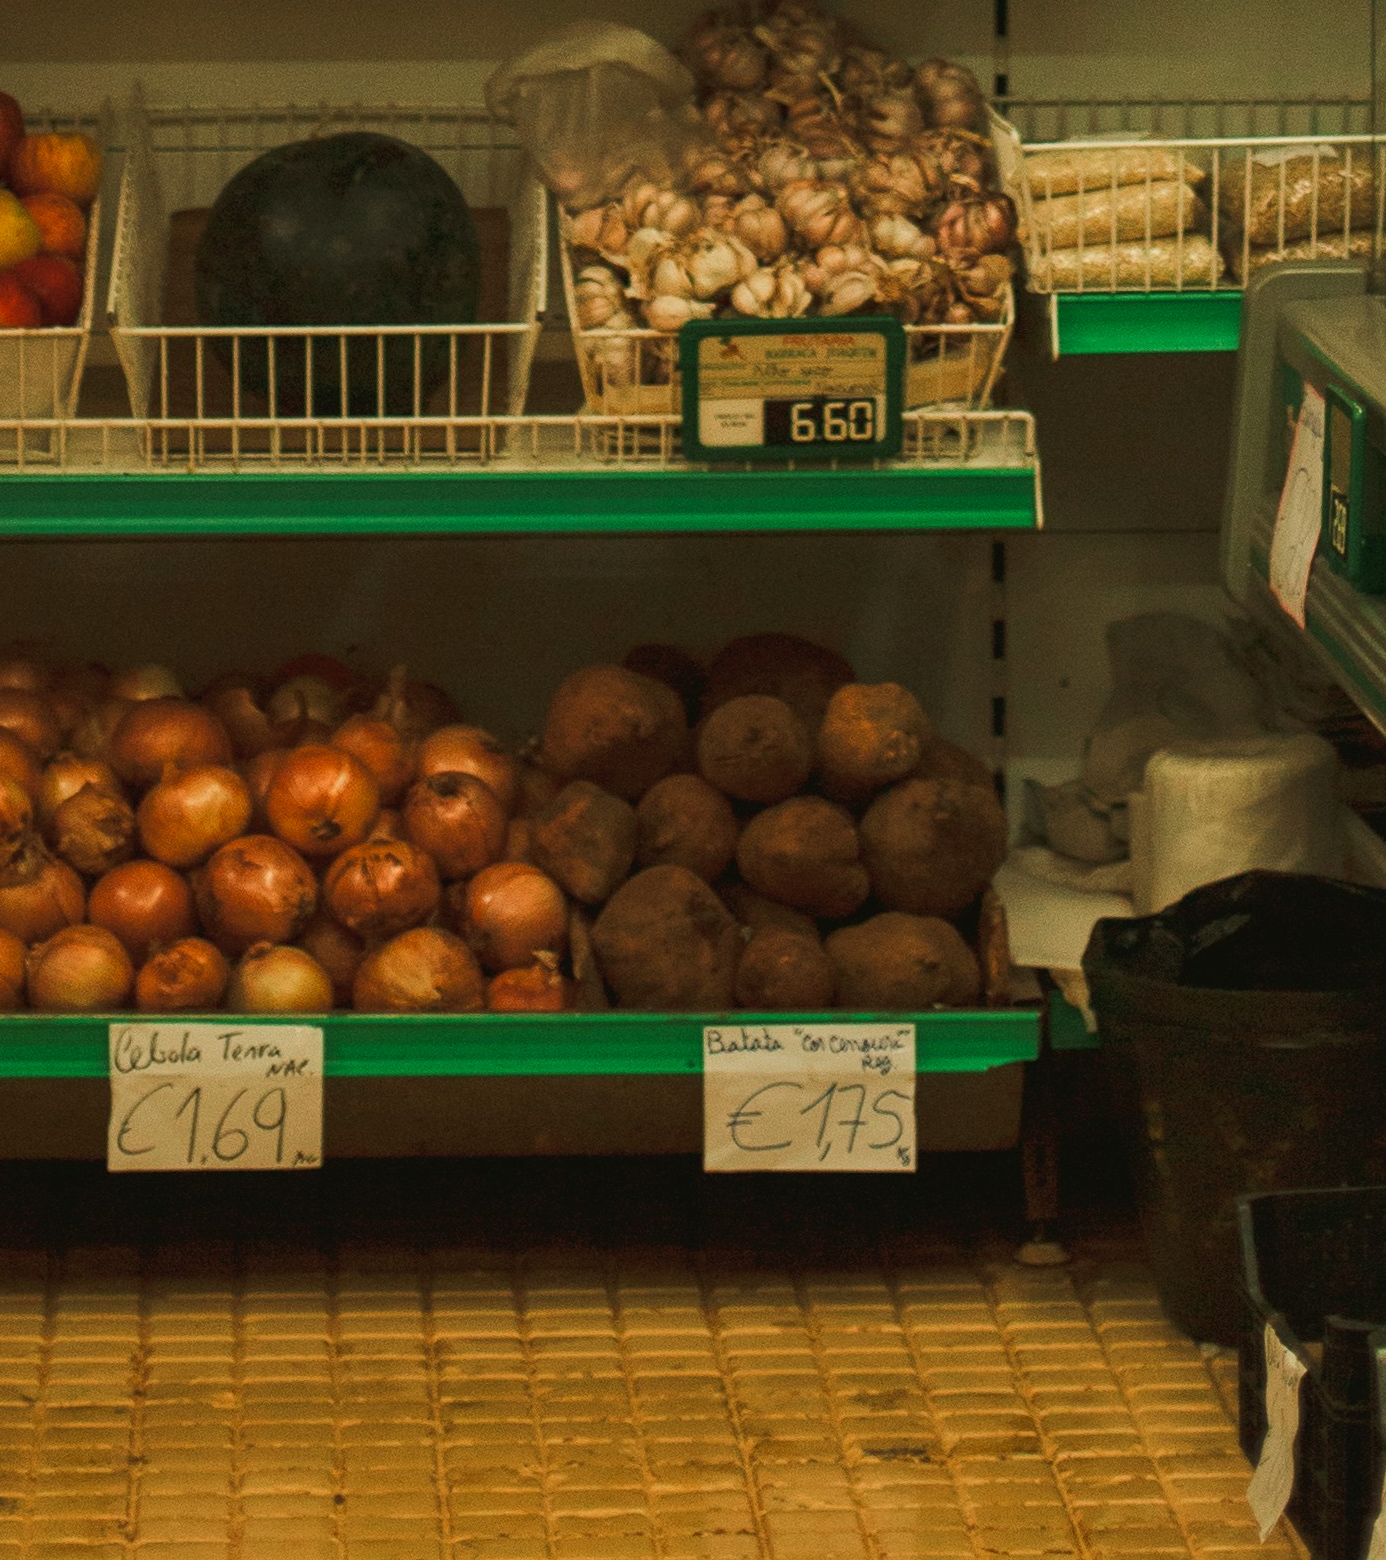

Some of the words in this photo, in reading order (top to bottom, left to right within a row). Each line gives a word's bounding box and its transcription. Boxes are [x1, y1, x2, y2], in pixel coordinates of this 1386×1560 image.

[790, 401, 874, 443] 6.60
[114, 1026, 202, 1074] Cebola
[117, 1082, 287, 1164] €1,69
[725, 1080, 912, 1162] €1,75
